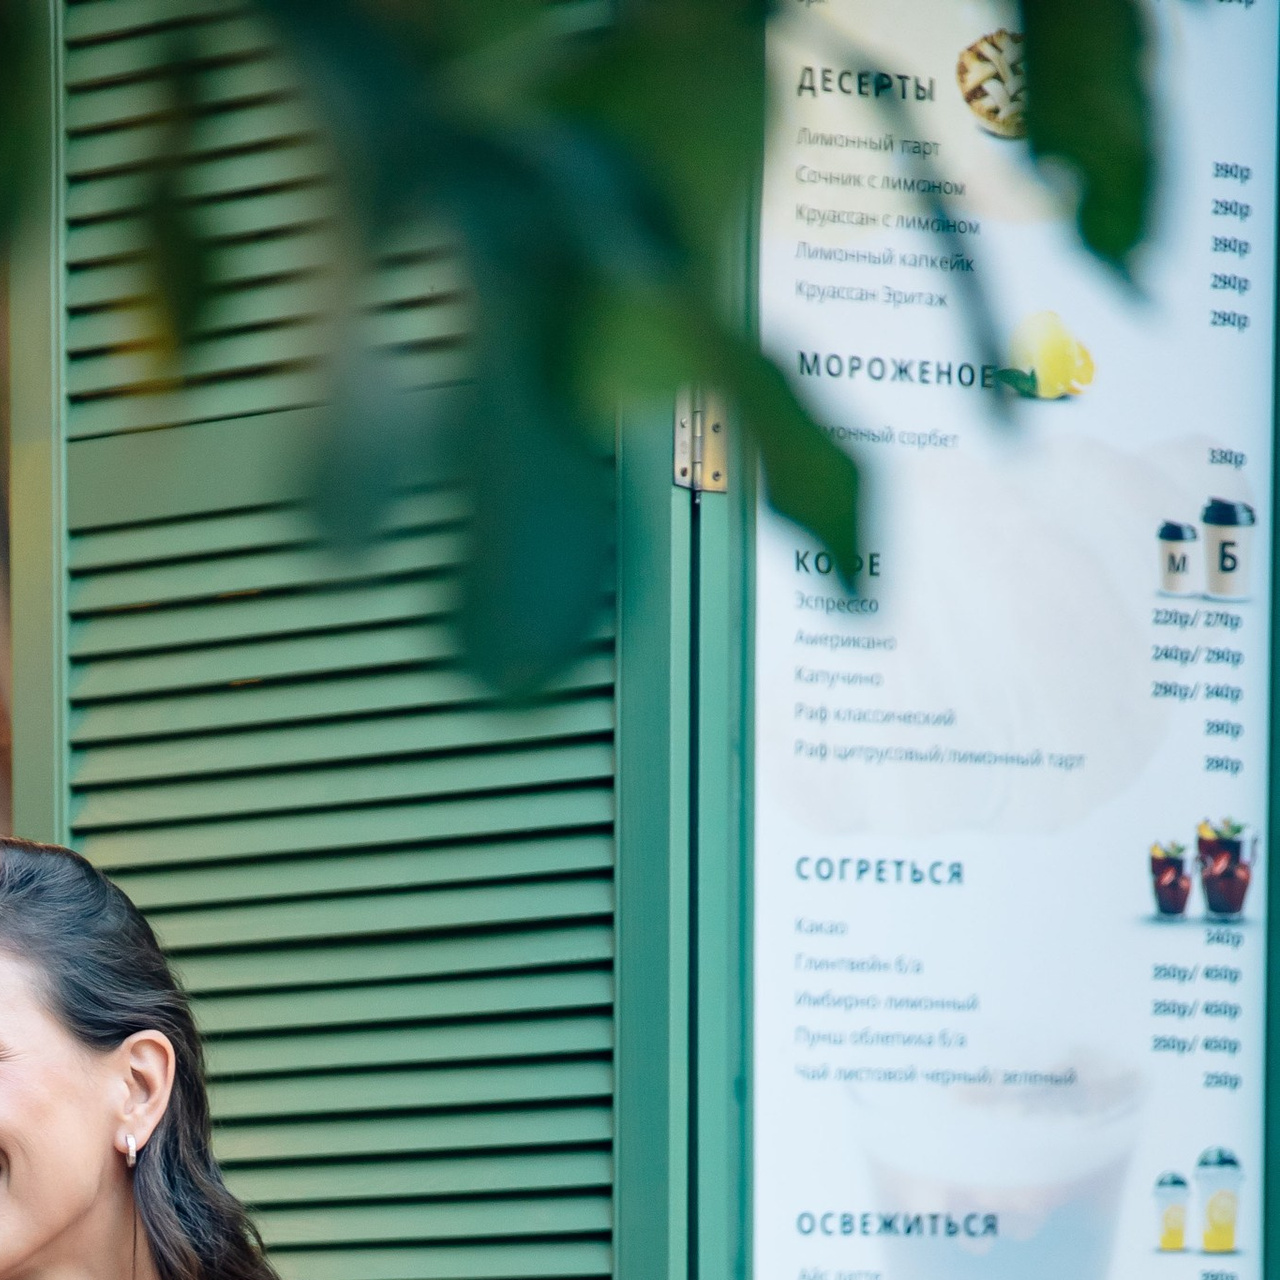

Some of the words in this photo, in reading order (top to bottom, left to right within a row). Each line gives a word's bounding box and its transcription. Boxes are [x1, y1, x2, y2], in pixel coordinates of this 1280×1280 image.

[797, 65, 936, 101] ДЕСЕРТЫ
[797, 127, 895, 153] Лимонный
[900, 139, 941, 160] тарт
[881, 173, 966, 196] лимоном
[795, 202, 878, 227] Круассан
[896, 212, 981, 235] лимоном
[795, 240, 894, 266] Лимонный
[899, 249, 975, 273] капкейк
[795, 279, 878, 303] Круассан
[882, 284, 948, 309] Эритаж
[799, 350, 996, 389] МОРОЖЕНОЕ
[820, 425, 893, 446] монный
[1219, 540, 1238, 573] Б
[794, 590, 880, 614] Эспрессо
[794, 629, 897, 652] Американо
[793, 665, 884, 689] Капучино
[794, 701, 828, 724] Раф
[833, 706, 957, 727] классический
[794, 739, 828, 762] Раф
[795, 855, 964, 886] СОГРЕТЬСЯ
[794, 917, 848, 936] Какао
[796, 1210, 999, 1237] ОСВЕЖИТЬСЯ
